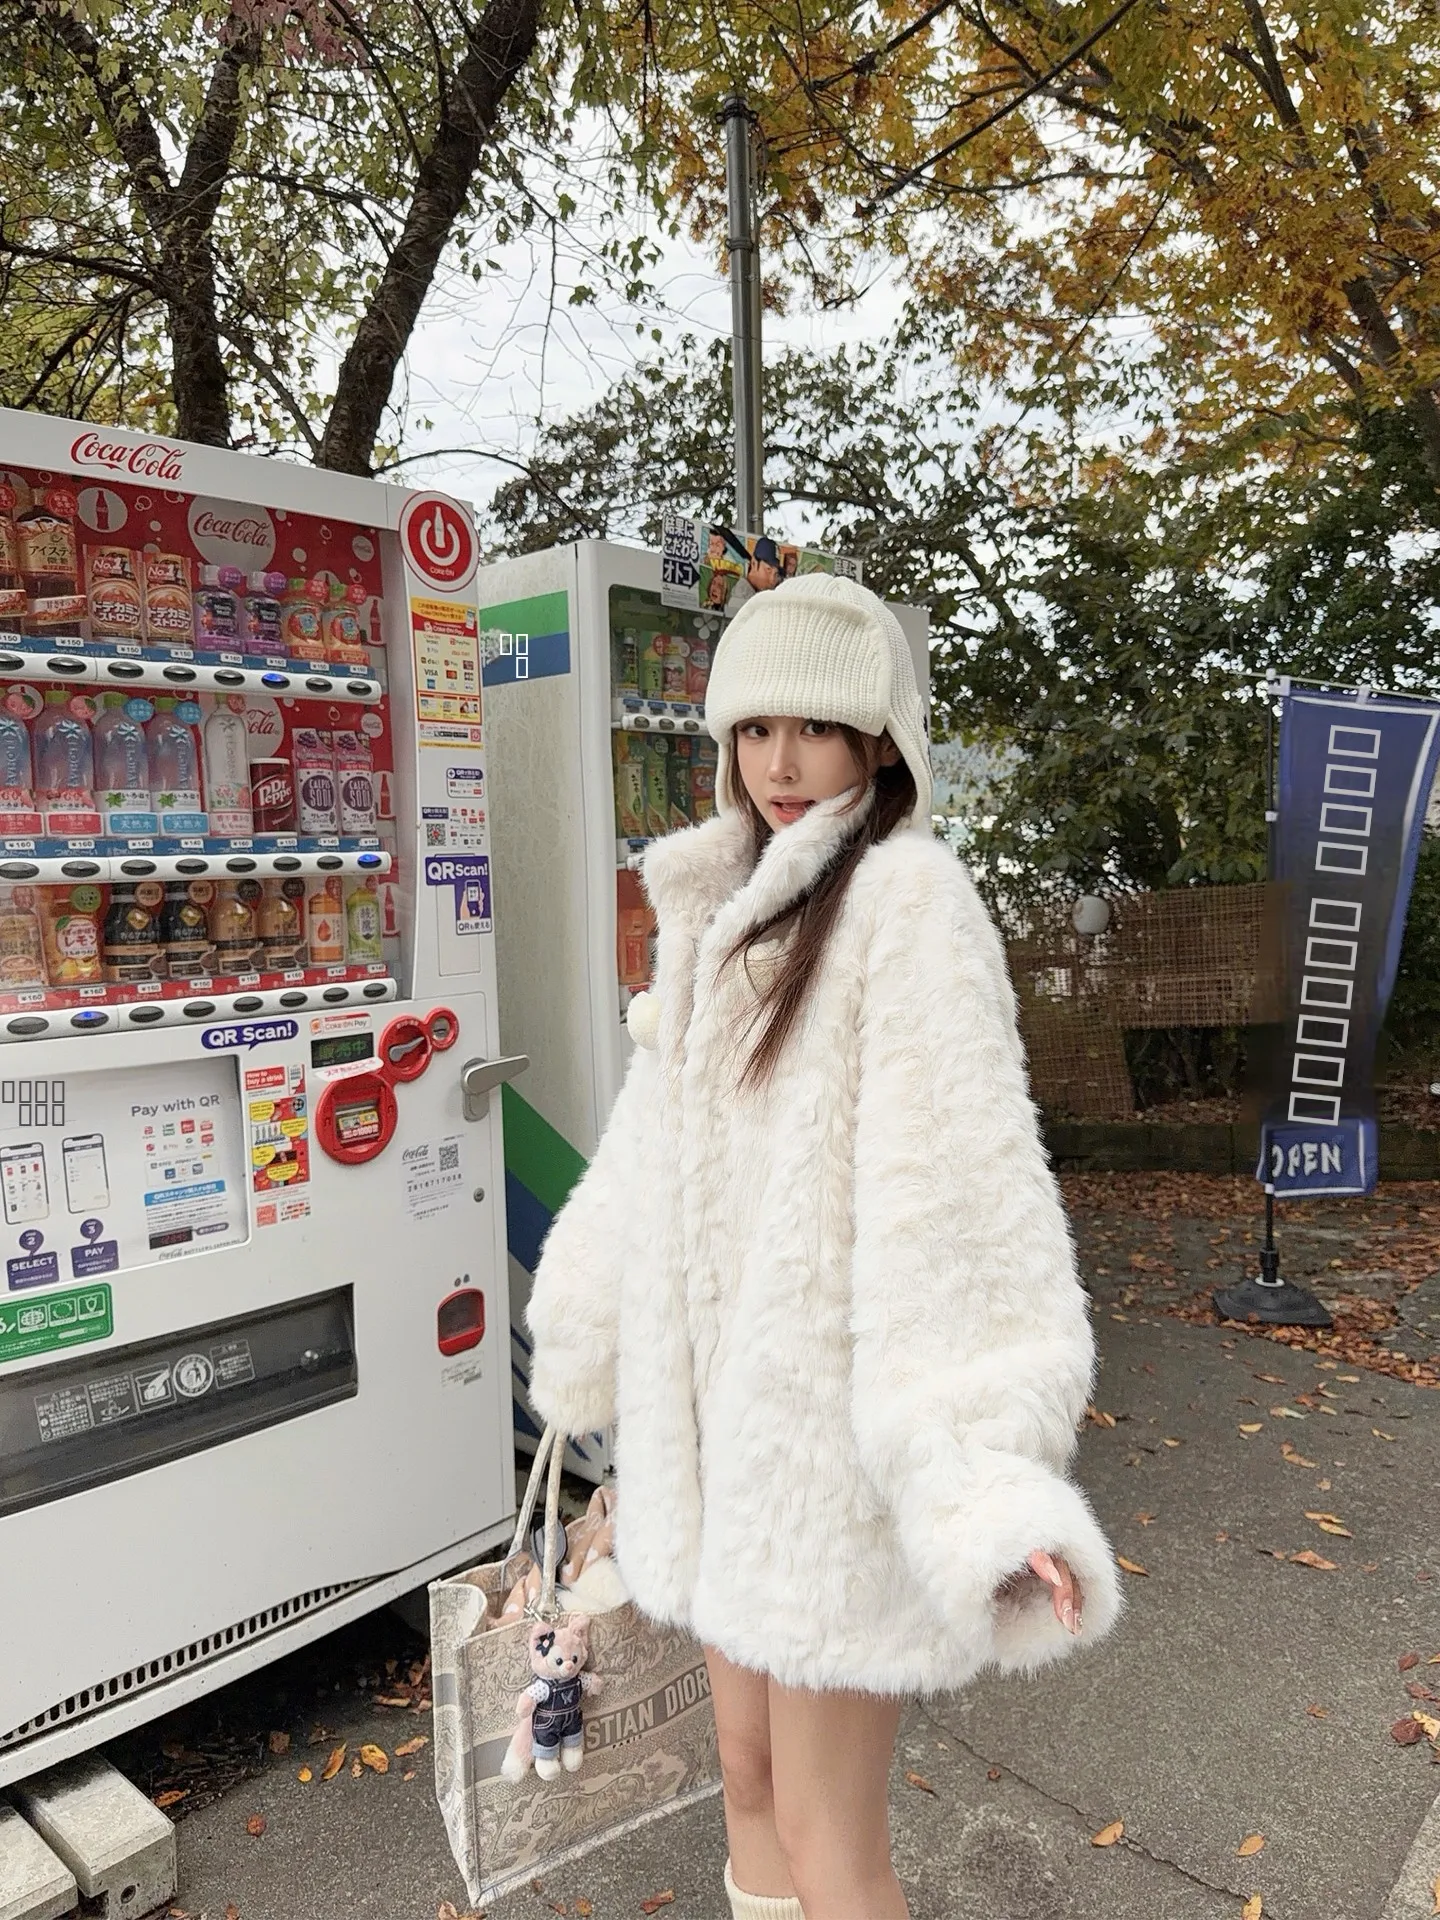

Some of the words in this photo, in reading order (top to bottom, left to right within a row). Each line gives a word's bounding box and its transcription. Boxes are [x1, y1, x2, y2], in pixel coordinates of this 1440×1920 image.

[71, 432, 187, 481] Coca-Cola
[193, 511, 270, 547] Coca-Cola
[665, 515, 695, 538] 結果に
[664, 537, 699, 560] こだわる
[92, 556, 122, 571] No.1
[664, 561, 693, 586] オトコ
[60, 638, 82, 647] ¥150
[424, 669, 439, 677] VISA
[271, 780, 287, 792] Dr
[427, 861, 456, 881] QR
[455, 863, 488, 877] Scan!
[65, 935, 97, 947] レモン
[354, 1019, 368, 1028] Pay
[208, 1031, 238, 1047] QR
[242, 1022, 292, 1042] Scan!
[131, 1104, 158, 1118] Pay
[163, 1098, 196, 1114] with
[200, 1094, 221, 1107] QR
[88, 1225, 97, 1235] 3
[27, 1236, 36, 1246] 2
[84, 1246, 104, 1257] PAY
[11, 1256, 55, 1273] SELECT
[585, 1698, 655, 1750] STIAN
[664, 1667, 711, 1718] DIOR
